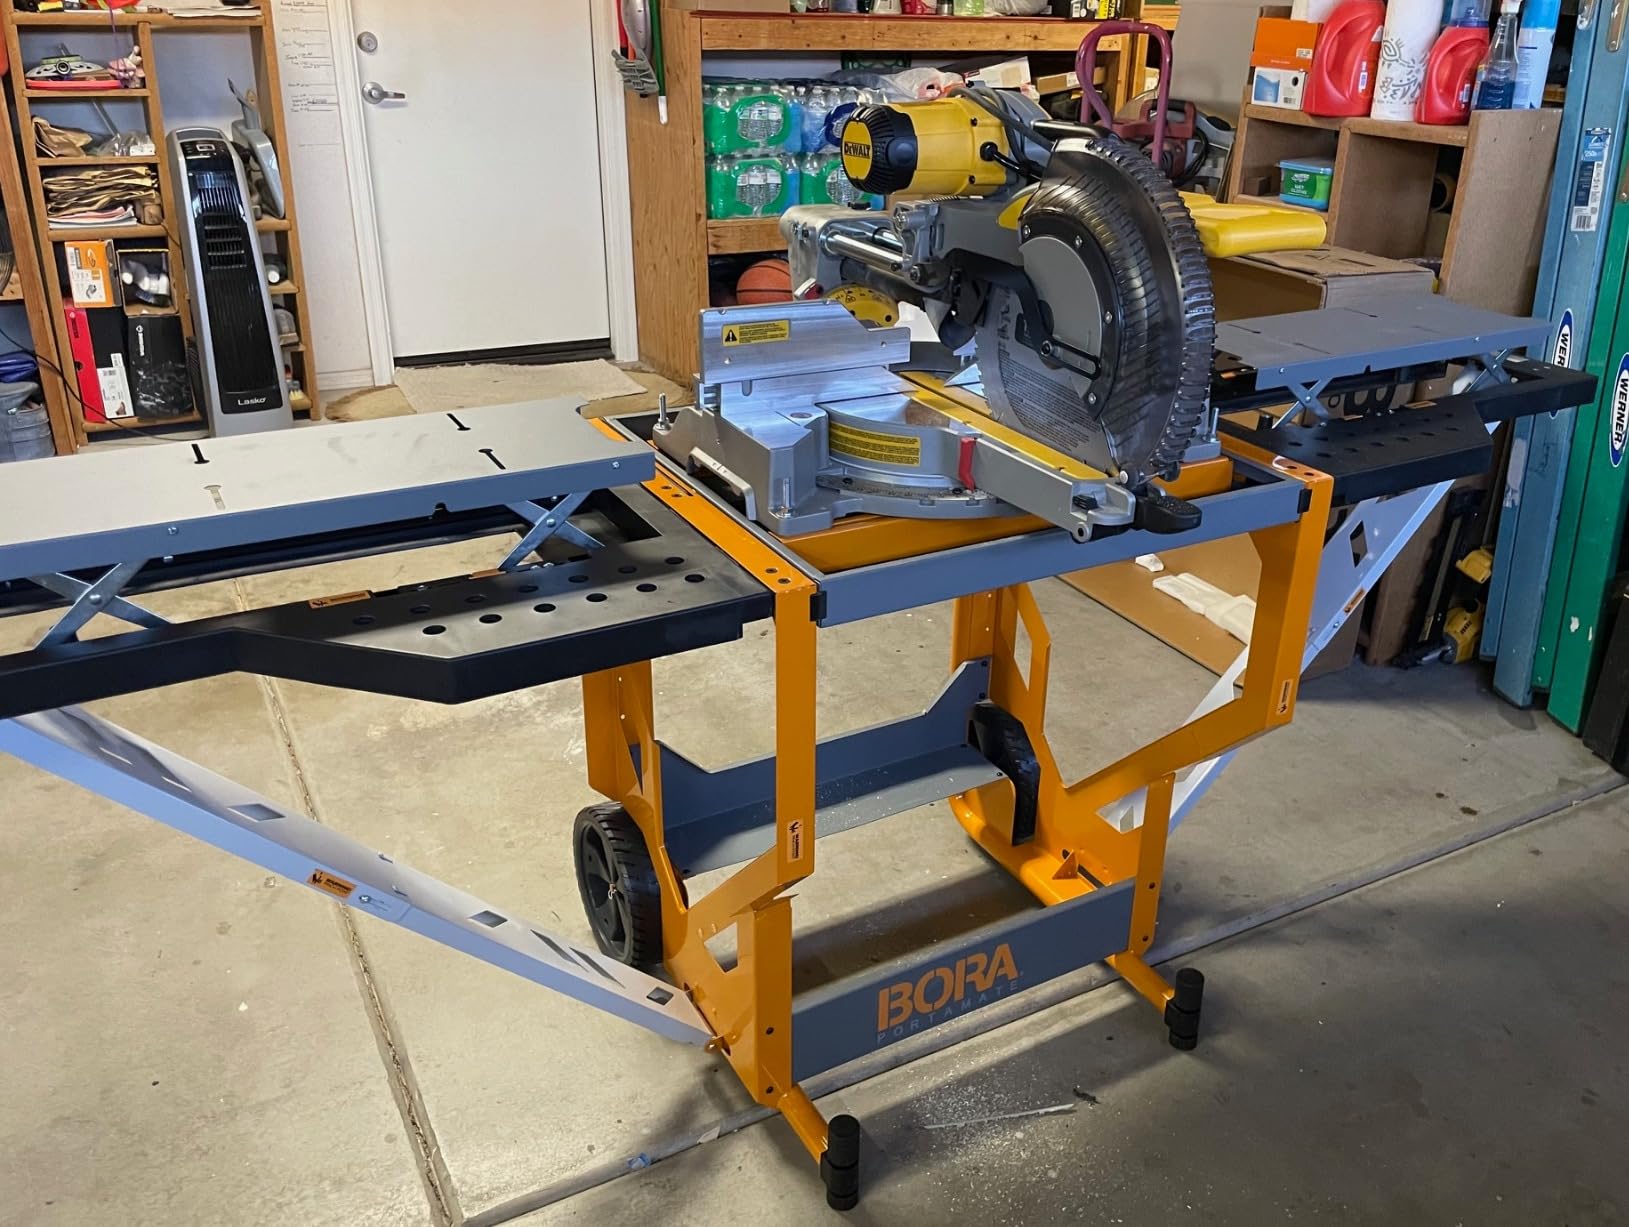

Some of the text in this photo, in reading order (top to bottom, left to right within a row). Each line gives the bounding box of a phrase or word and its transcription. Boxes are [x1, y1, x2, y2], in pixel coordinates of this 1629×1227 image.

[1557, 332, 1569, 368] WER
[237, 397, 267, 406] Lasko
[1614, 378, 1629, 443] WERNER
[877, 943, 1019, 1033] BORA
[877, 980, 1019, 1044] PORTAMATE
